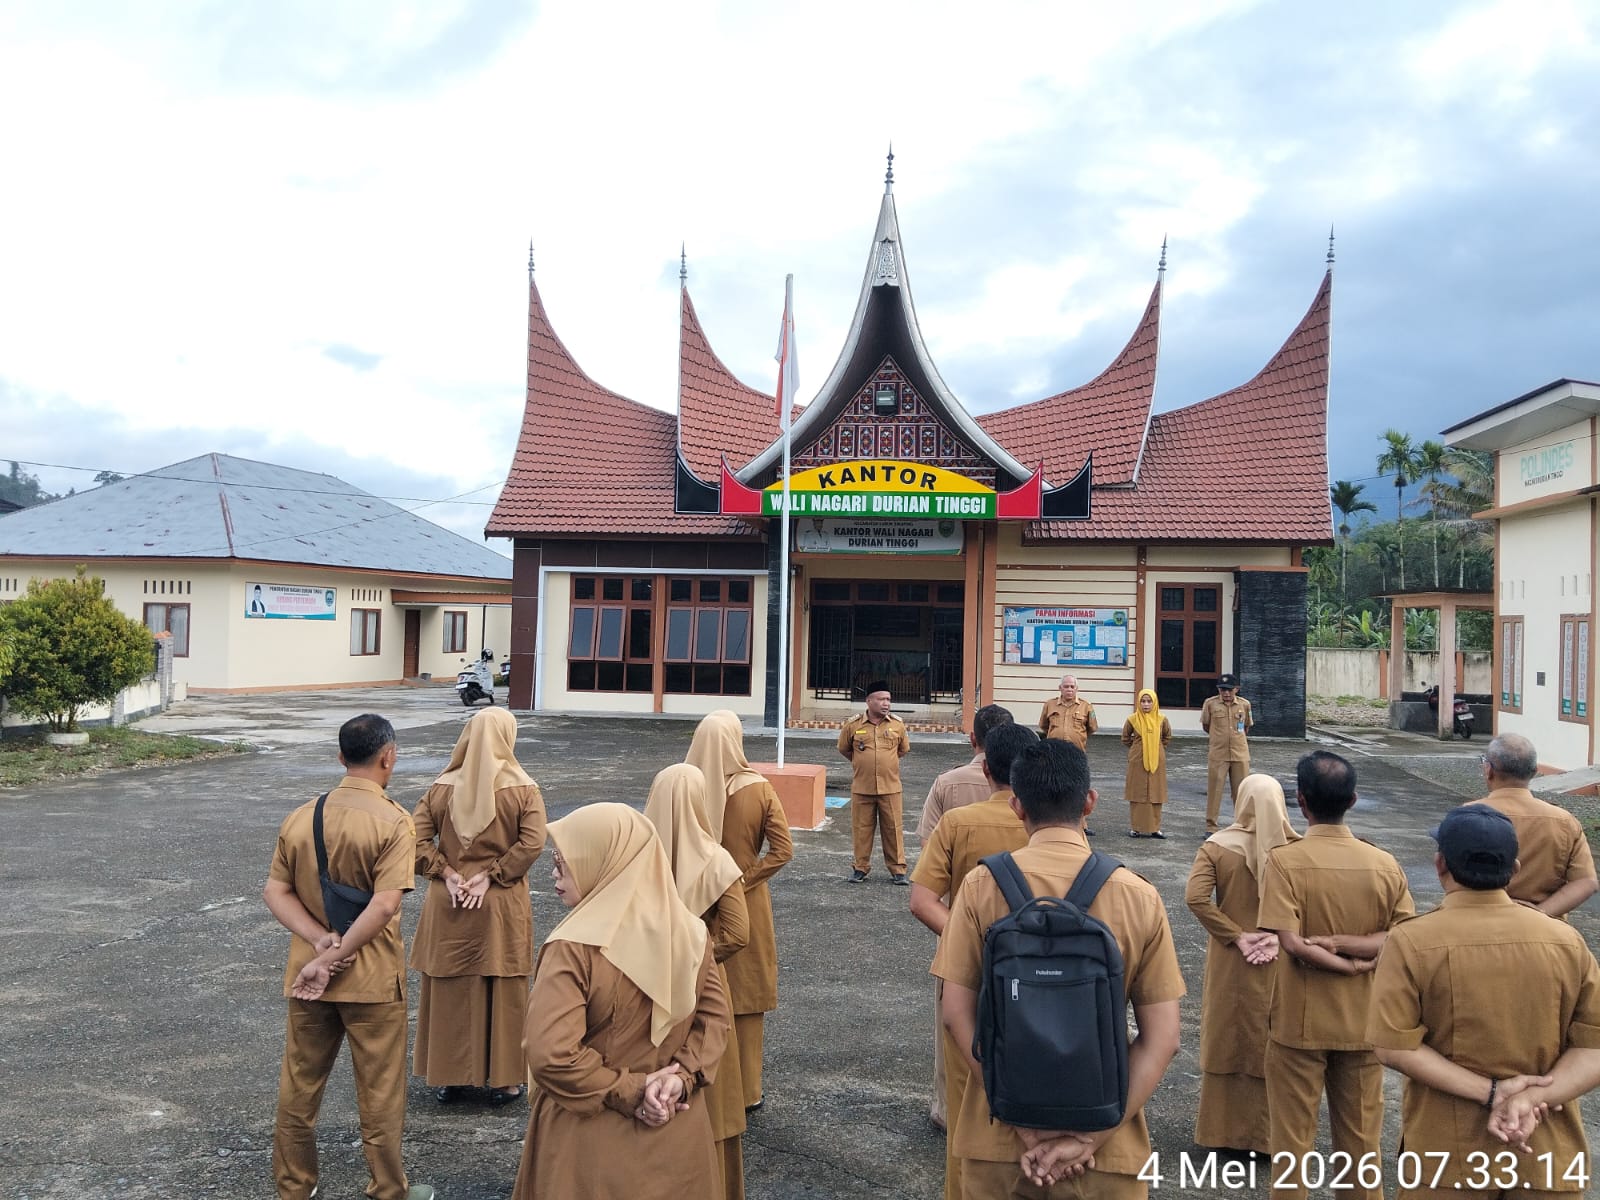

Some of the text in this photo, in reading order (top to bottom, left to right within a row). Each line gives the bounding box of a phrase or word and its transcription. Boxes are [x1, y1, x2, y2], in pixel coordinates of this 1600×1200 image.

[1519, 443, 1574, 481] POLINDES
[818, 465, 937, 490] KANTOR
[811, 494, 867, 512] NAGARI
[872, 495, 930, 513] DURIAN
[935, 496, 986, 514] TINGGI
[834, 527, 934, 537] KANTOR WALI NAGARI
[848, 538, 918, 547] DURIAN TINGGI
[1035, 609, 1096, 618] PAPAN INFORMASI
